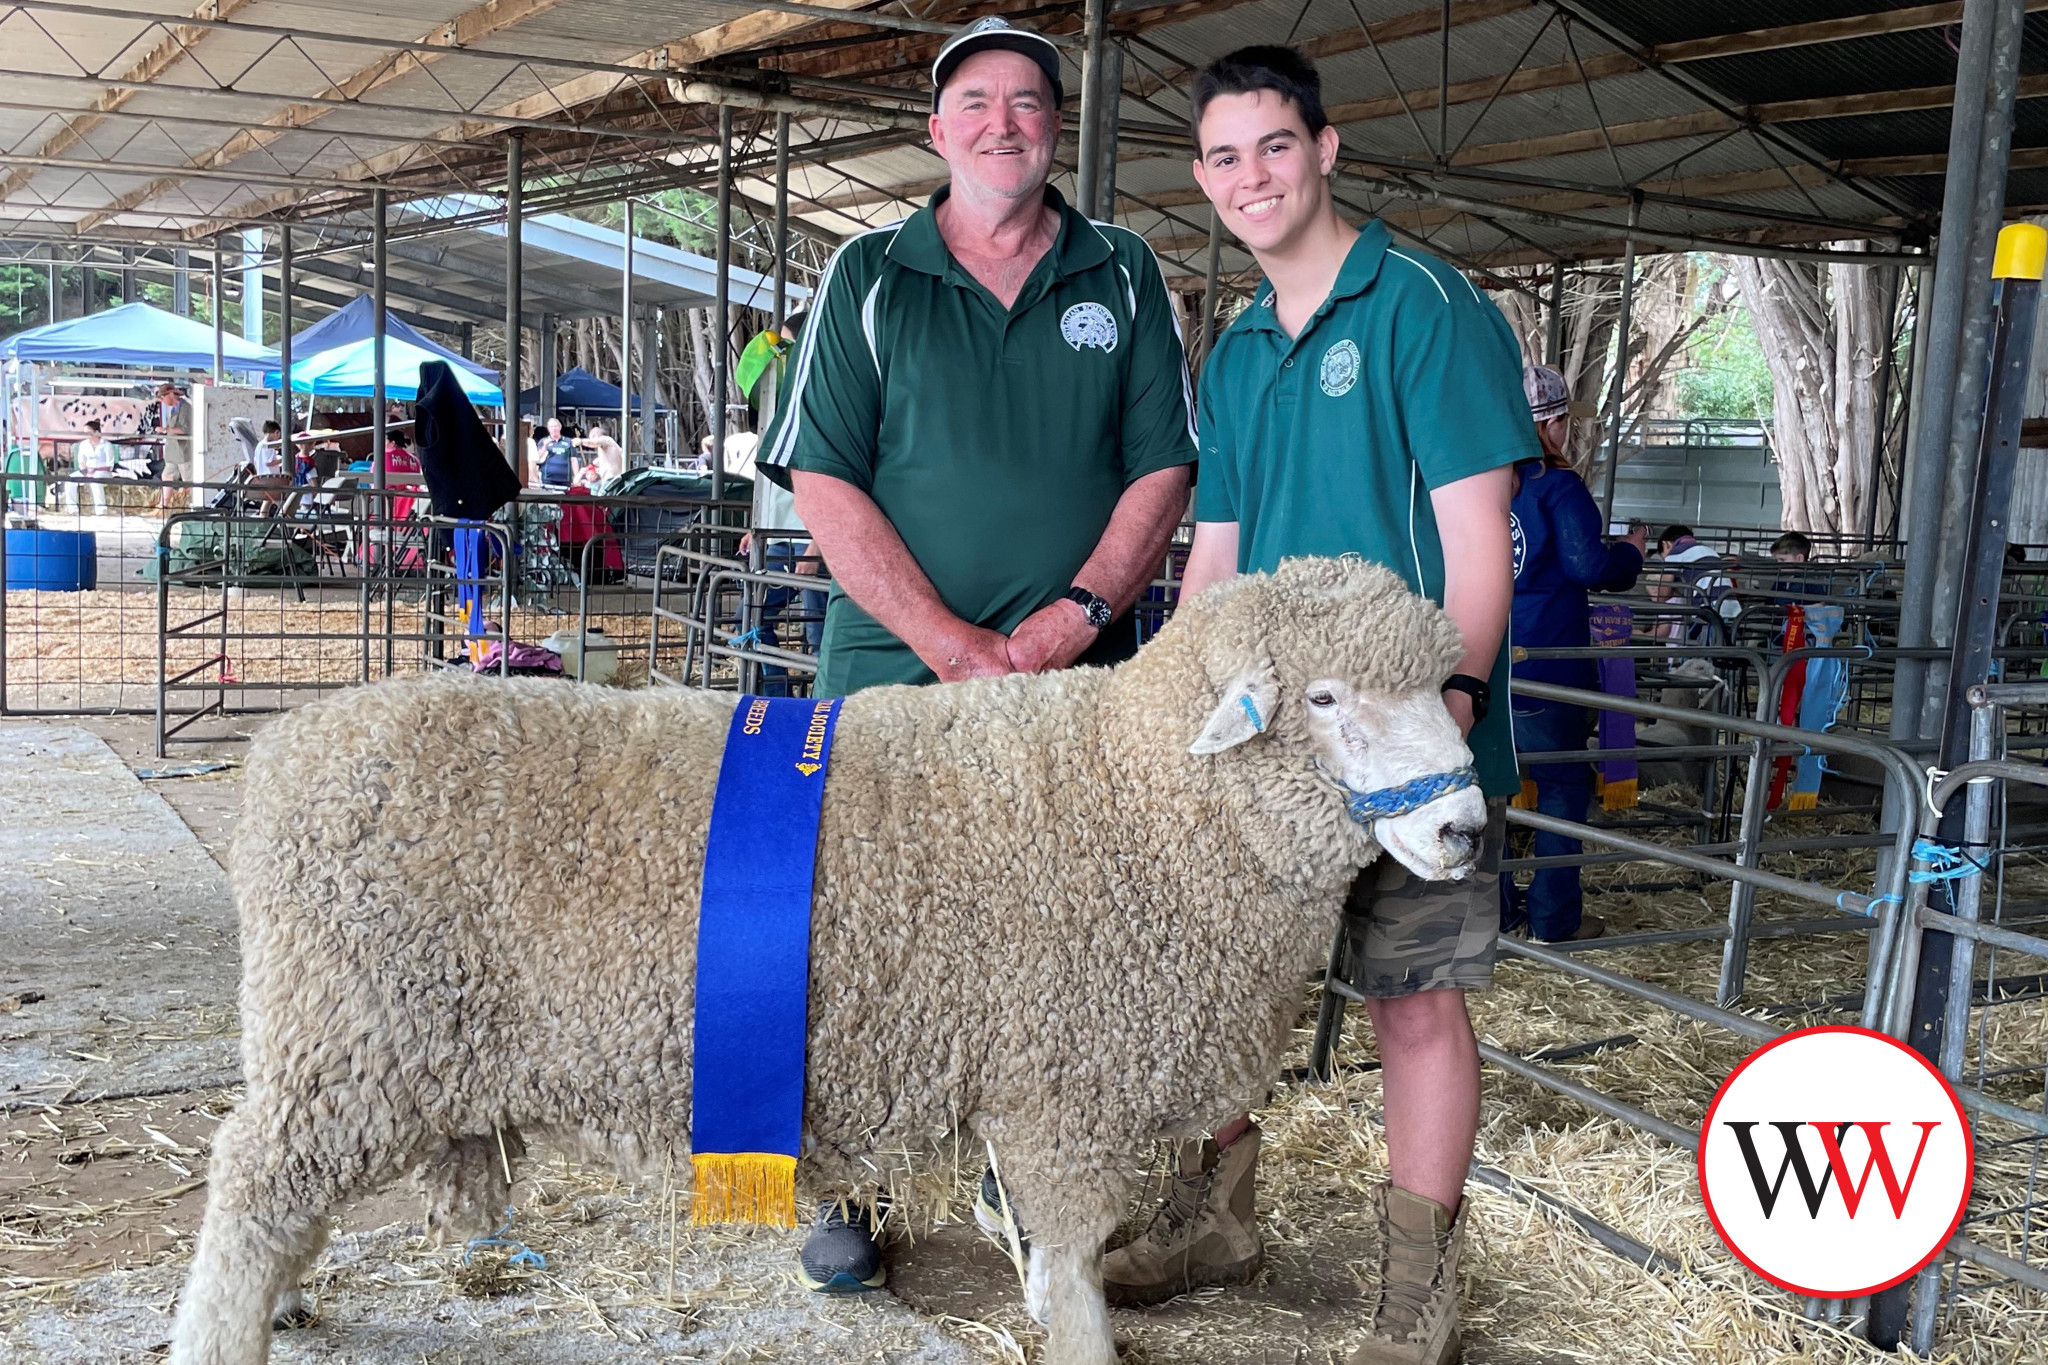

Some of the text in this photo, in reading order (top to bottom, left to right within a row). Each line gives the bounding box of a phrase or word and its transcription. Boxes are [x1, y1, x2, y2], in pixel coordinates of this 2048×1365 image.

[743, 699, 770, 735] BREEDS
[802, 699, 835, 760] RAL SOCIETY
